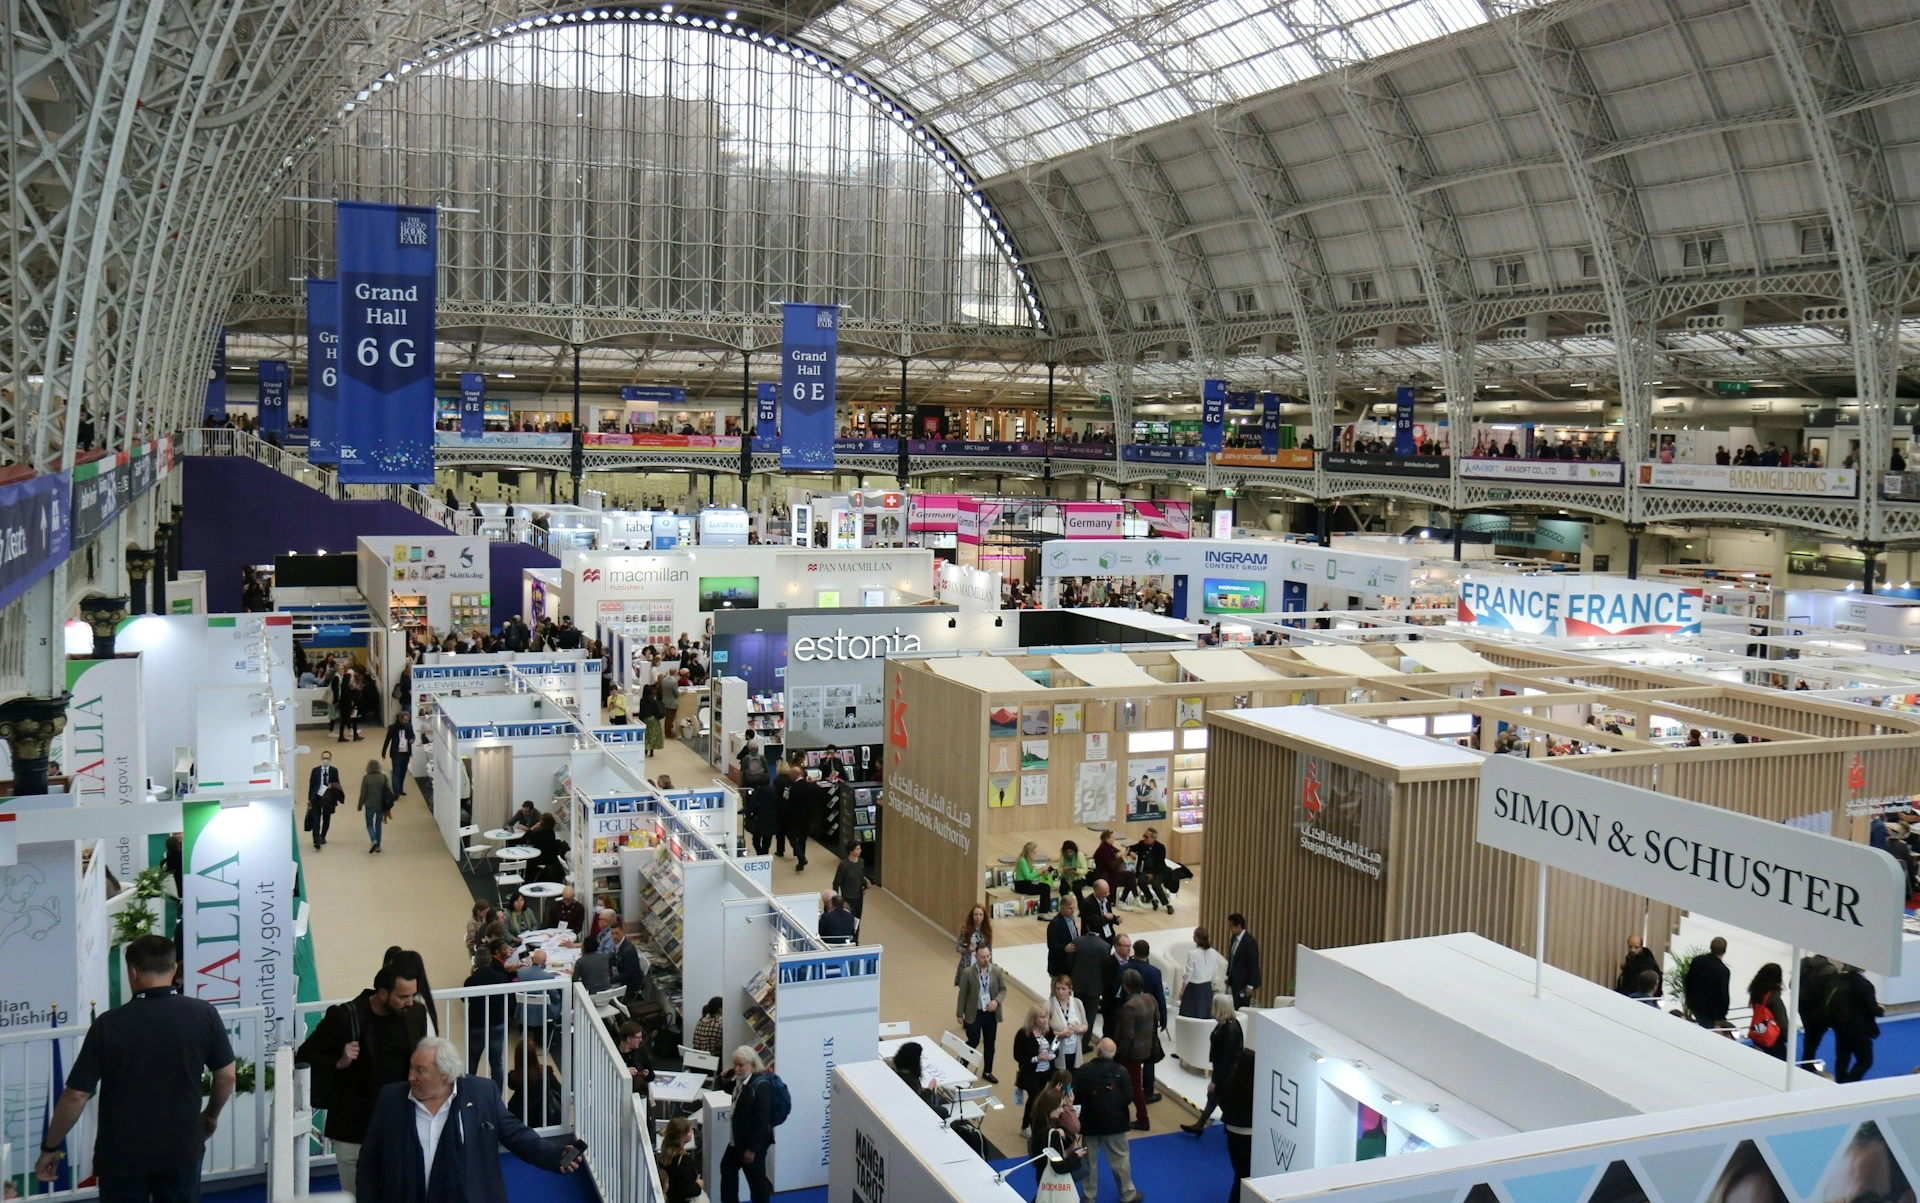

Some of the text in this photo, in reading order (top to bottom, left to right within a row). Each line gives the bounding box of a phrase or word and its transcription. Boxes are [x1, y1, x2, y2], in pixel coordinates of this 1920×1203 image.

[400, 228, 427, 237] BOOK
[400, 236, 428, 244] FAIR
[355, 284, 418, 302] Grand
[366, 308, 407, 325] Hall
[357, 337, 416, 368] 6 G
[792, 351, 827, 361] Grand
[797, 365, 820, 375] Hall
[793, 382, 824, 400] 6 E
[264, 397, 282, 406] 6 G
[1206, 414, 1220, 423] 6 C
[1836, 414, 1850, 422] Lift
[916, 511, 956, 520] Germany
[626, 520, 652, 532] faber
[1069, 518, 1112, 530] Germany
[1205, 551, 1267, 564] INGRAM
[819, 563, 892, 572] PAN MACMILLAN
[1813, 563, 1827, 572] Lift
[610, 568, 688, 582] macmillan
[960, 583, 993, 602] MACMILLAN
[1462, 582, 1560, 621] FRANCE
[1569, 592, 1693, 624] FRANCE
[794, 627, 920, 661] estonia
[422, 681, 484, 689] LLEWELLYN
[599, 818, 639, 833] PGUK
[888, 791, 970, 855] Sharjah Book Authority
[1301, 836, 1380, 879] Sharjah Book Authority
[1495, 787, 1864, 927] SIMON & SCHUSTER
[744, 861, 770, 871] 6E30
[824, 1037, 834, 1057] UK
[856, 1128, 884, 1186] MANGA
[856, 1155, 884, 1203] TAROT
